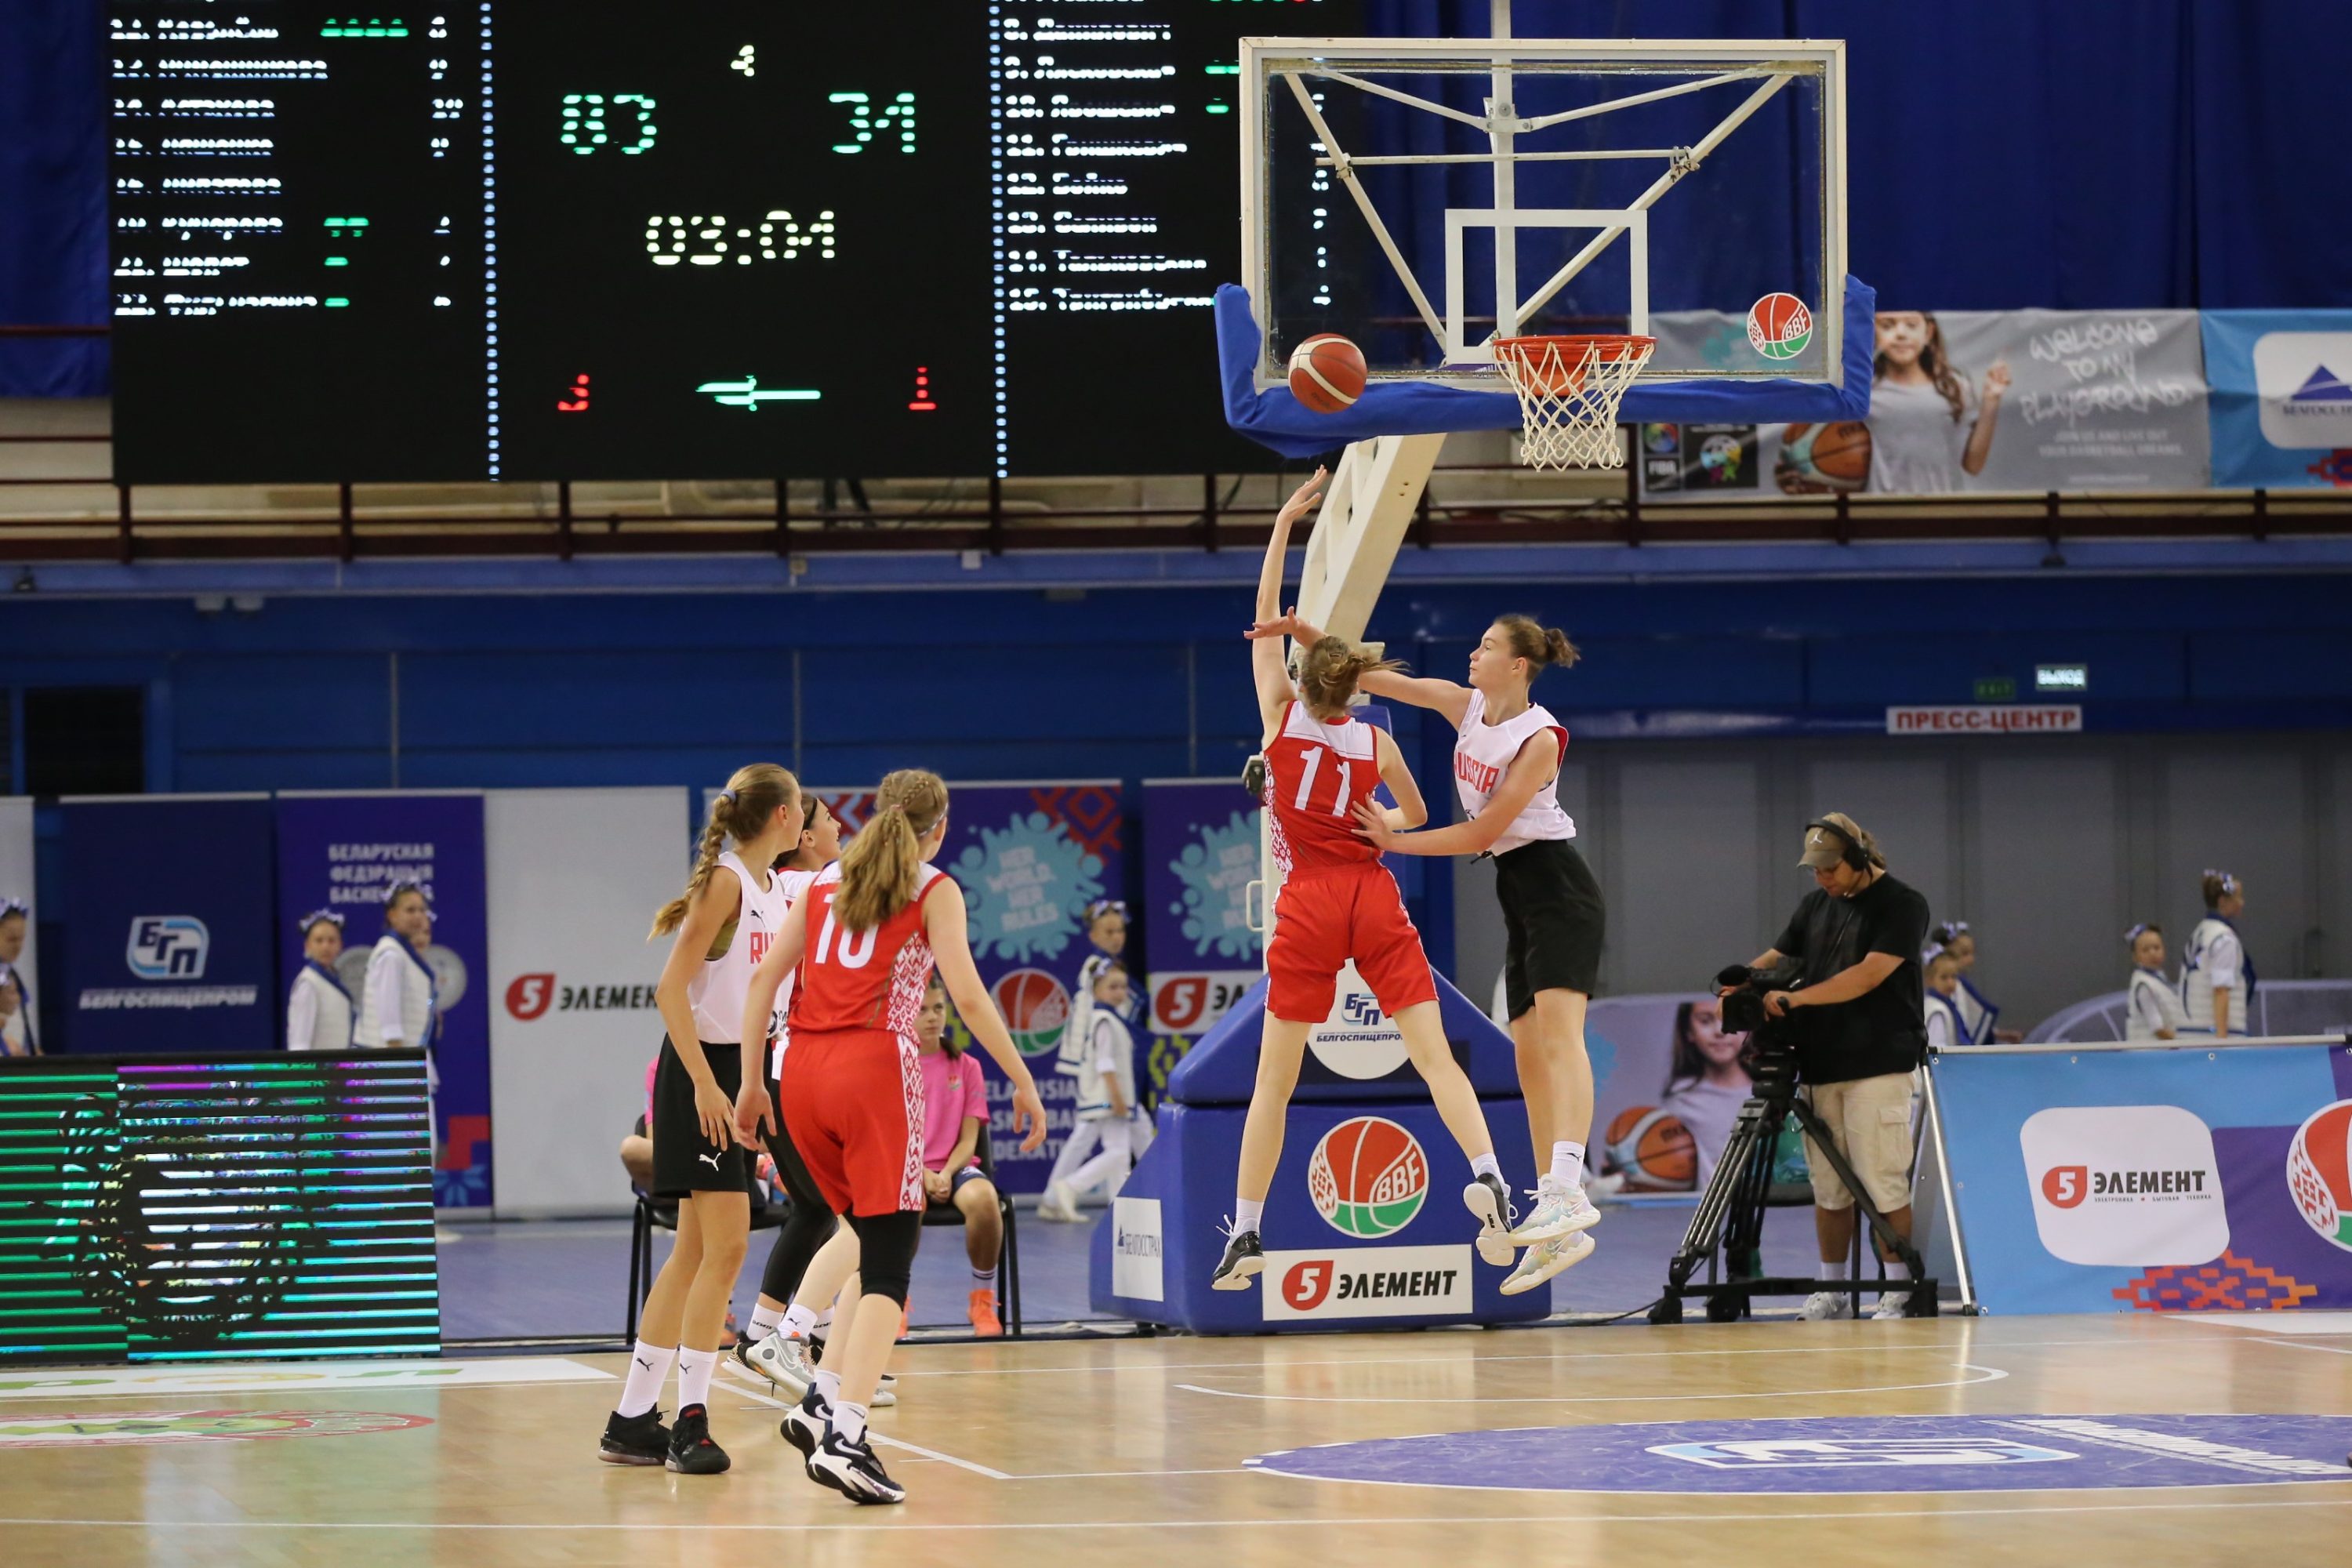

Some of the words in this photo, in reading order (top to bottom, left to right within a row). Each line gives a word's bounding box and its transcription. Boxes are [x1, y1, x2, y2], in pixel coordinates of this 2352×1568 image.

[1785, 308, 1807, 339] BBF
[2062, 357, 2097, 383] TO
[2037, 669, 2085, 686] ВЫХОД
[1896, 710, 2076, 732] ПРЕСС-ЦЕНТР
[1294, 746, 1352, 818] 11
[137, 921, 198, 974] БГП
[517, 979, 544, 1014] 5
[560, 985, 659, 1011] ЭЛЕМЕН
[1169, 984, 1196, 1020] 5
[1345, 993, 1381, 1026] БГП
[1316, 1033, 1403, 1043] БЕЛГОСПИЩЕПРО
[1376, 1150, 1421, 1203] BBF
[2056, 1171, 2076, 1201] 5
[2093, 1171, 2206, 1194] ЭЛЕМЕНТ
[1295, 1267, 1321, 1301] 5
[1337, 1270, 1457, 1299] ЭЛЕМЕНТ
